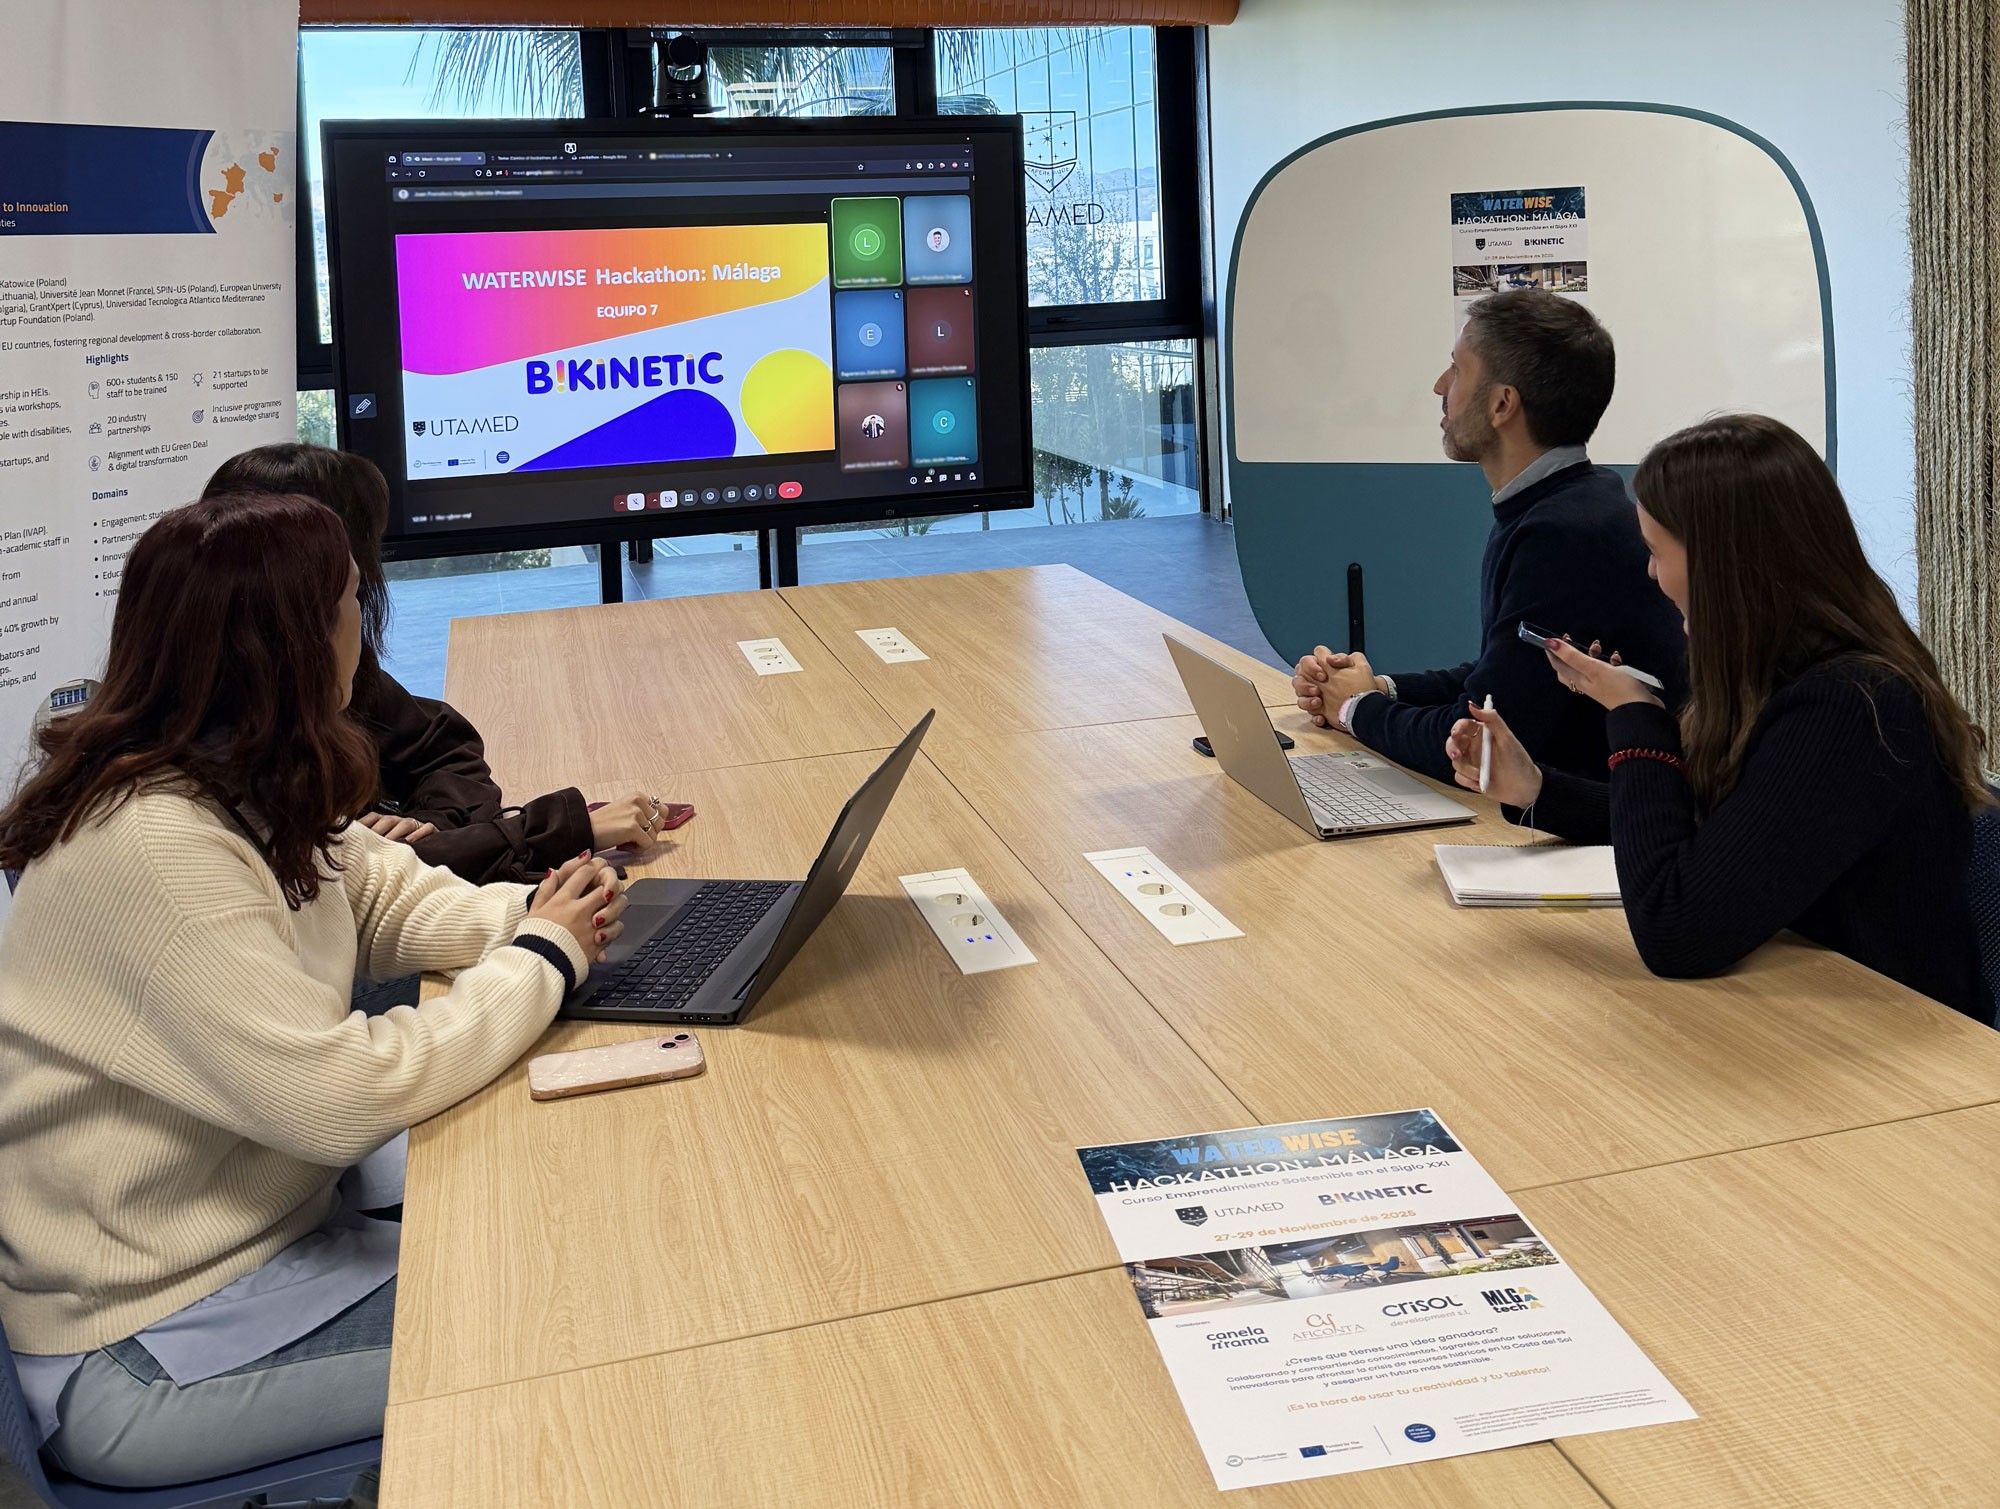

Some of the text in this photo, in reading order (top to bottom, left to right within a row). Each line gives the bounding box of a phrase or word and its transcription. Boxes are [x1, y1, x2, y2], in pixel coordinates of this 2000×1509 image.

[3, 201, 69, 212] to Innovation
[1483, 196, 1555, 211] WATERWISE
[1025, 203, 1105, 227] AMED
[863, 236, 871, 248] L
[36, 277, 67, 288] (Poland)
[462, 262, 781, 290] WATERWISE Hackathon: Málaga
[40, 290, 77, 299] Université
[79, 289, 95, 299] Jean
[97, 288, 125, 297] Monnet
[157, 284, 187, 294] SPIN-US
[220, 283, 251, 293] European
[252, 282, 281, 291] University
[29, 302, 71, 313] GrantXpert
[106, 299, 147, 309] Universidad
[596, 304, 659, 319] EQUIPO 7
[18, 315, 62, 325] Foundation
[867, 330, 875, 341] E
[937, 326, 945, 337] L
[1, 341, 13, 351] EU
[14, 340, 52, 351] countries,
[53, 338, 88, 349] fostering
[88, 335, 118, 347] regional
[119, 332, 163, 343] development
[171, 329, 216, 339] cross-border
[85, 353, 129, 366] Highlights
[106, 372, 179, 387] 600+ students & 150
[223, 367, 269, 378] startups to be
[106, 385, 168, 398] staff to be trained
[212, 380, 248, 391] supported
[22, 390, 30, 398] in
[5, 404, 17, 413] via
[18, 400, 62, 412] workshops,
[212, 399, 282, 413] Inclusive programmes
[107, 413, 147, 425] 20 industry
[219, 411, 280, 423] knowledge sharing
[940, 417, 948, 428] C
[12, 426, 72, 439] with disabilities,
[107, 424, 151, 437] partnerships
[430, 415, 519, 437] UTAMED
[108, 440, 208, 460] Alignment with EU Green Deal
[35, 453, 50, 463] and
[108, 454, 188, 472] & digital transformation
[92, 488, 129, 500] Domains
[101, 514, 148, 528] Engagement:
[4, 531, 22, 540] Plan
[43, 536, 70, 547] staff in
[2, 571, 21, 581] from
[12, 592, 39, 606] annual
[4, 623, 20, 634] 40%
[21, 617, 48, 633] growth
[49, 616, 60, 626] by
[25, 644, 40, 656] and
[21, 671, 37, 682] and
[1171, 1128, 1361, 1165] WATERWISE
[1109, 1144, 1445, 1194] HACKATHON: MÁLAGA
[1122, 1160, 1450, 1206] Curso Emprendimiento Sostenible en el Siglo XXI
[1214, 1201, 1284, 1218] UTAMED
[1214, 1210, 1416, 1242] 27-29 de Noviembre de 2025
[1493, 1302, 1529, 1314] tech
[1390, 1311, 1456, 1328] development
[1206, 1326, 1265, 1341] canela
[1292, 1323, 1365, 1342] AFICONTA
[1284, 1326, 1499, 1367] ¿Crees que tienes una idea ganadora?
[1226, 1370, 1290, 1384] Colaborando
[1298, 1358, 1366, 1375] compartiendo
[1438, 1338, 1481, 1352] lograréis
[1482, 1334, 1516, 1347] diseñar
[1517, 1328, 1566, 1340] soluciones
[1230, 1336, 1573, 1391] innovadoras para afrontar crisis de recursos hídricos en Costa del Sol
[1331, 1356, 1493, 1388] asegurar un futuro más sostenible.
[1287, 1366, 1552, 1413] ¡Es la hora de usar tu creatividad tu talento!
